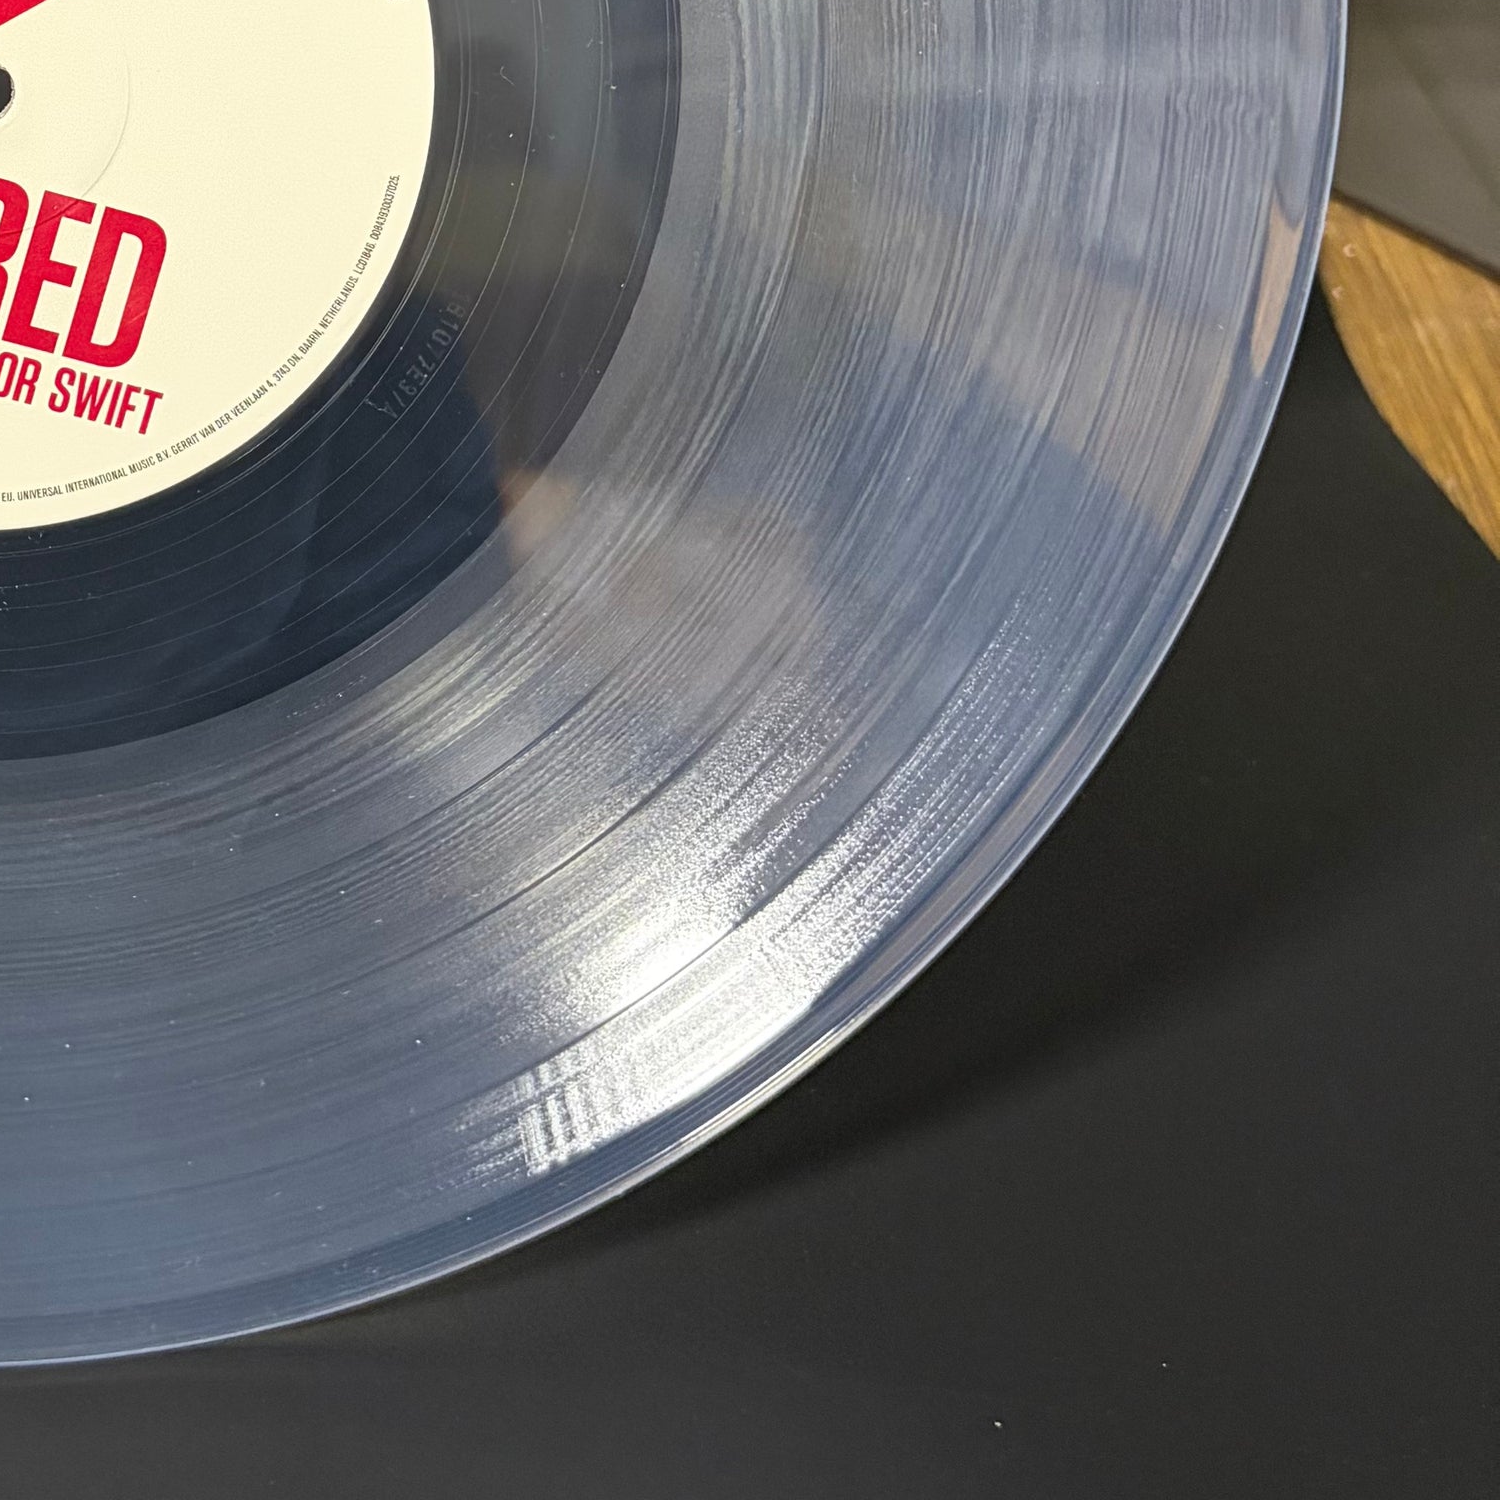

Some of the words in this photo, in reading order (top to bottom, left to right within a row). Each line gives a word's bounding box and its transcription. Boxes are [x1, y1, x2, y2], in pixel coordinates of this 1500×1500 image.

[17, 485, 64, 501] UNIVERSAL
[64, 467, 128, 494] INTERNATIONAL
[128, 455, 156, 474] MUSIC
[170, 432, 200, 455] GERRIT
[198, 423, 217, 439] VAN
[214, 412, 233, 429] DER
[230, 384, 269, 417] VEENLAAN
[272, 363, 291, 382] 3743
[47, 366, 164, 435] SWIFT
